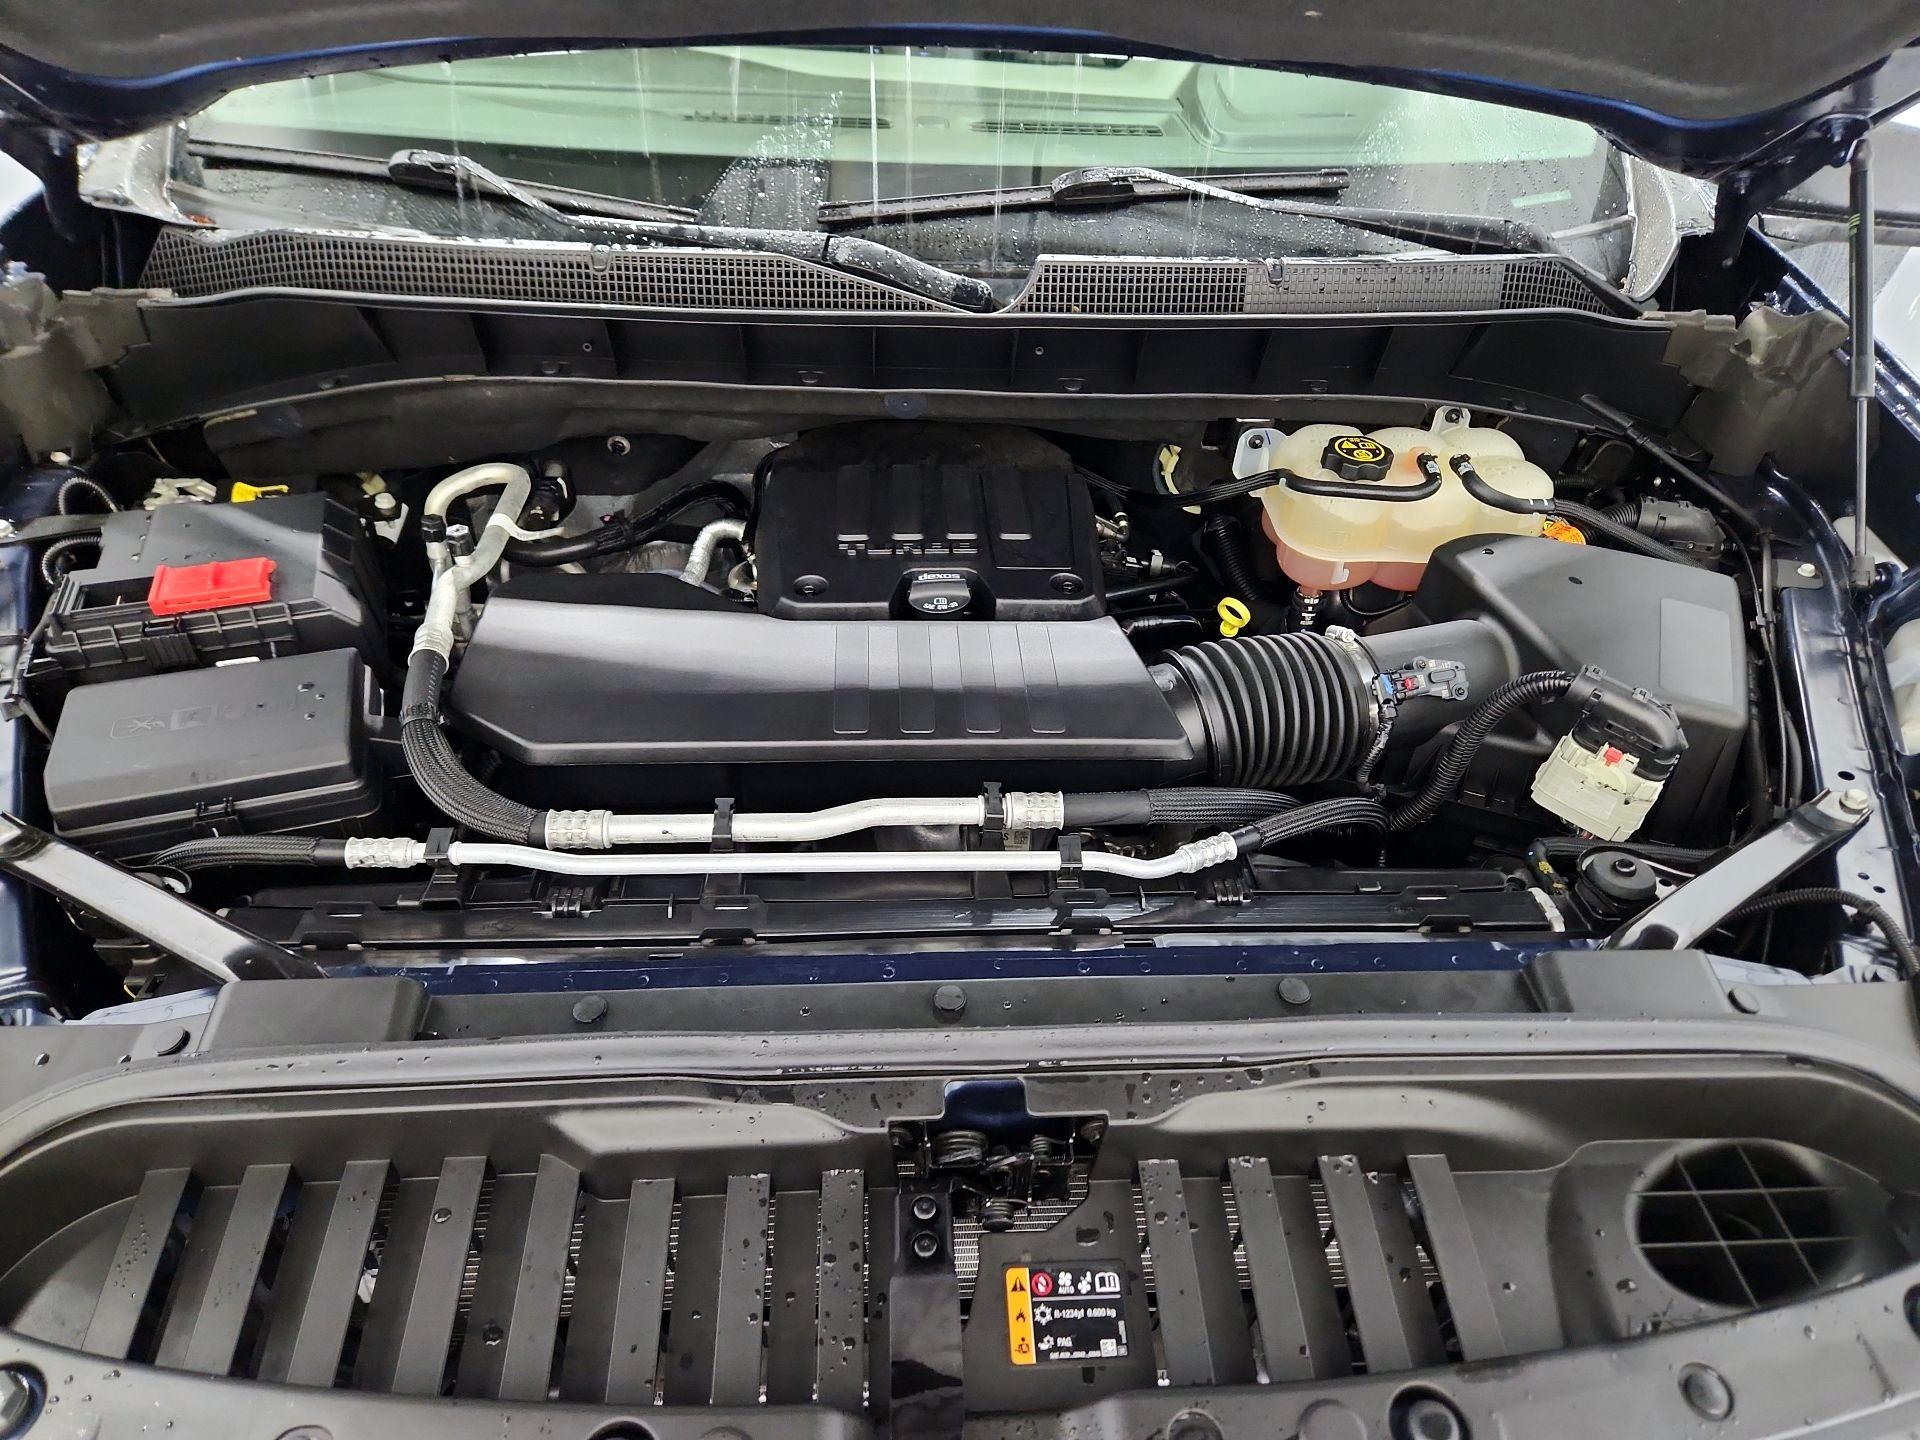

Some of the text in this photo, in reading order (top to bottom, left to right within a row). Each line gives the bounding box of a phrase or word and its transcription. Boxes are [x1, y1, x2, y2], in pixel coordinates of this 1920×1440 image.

[918, 573, 960, 581] dexos
[1058, 1286, 1075, 1295] AUTO
[1054, 1308, 1084, 1319] R-1234yf
[1107, 1308, 1116, 1318] kg
[1057, 1337, 1072, 1347] PAG
